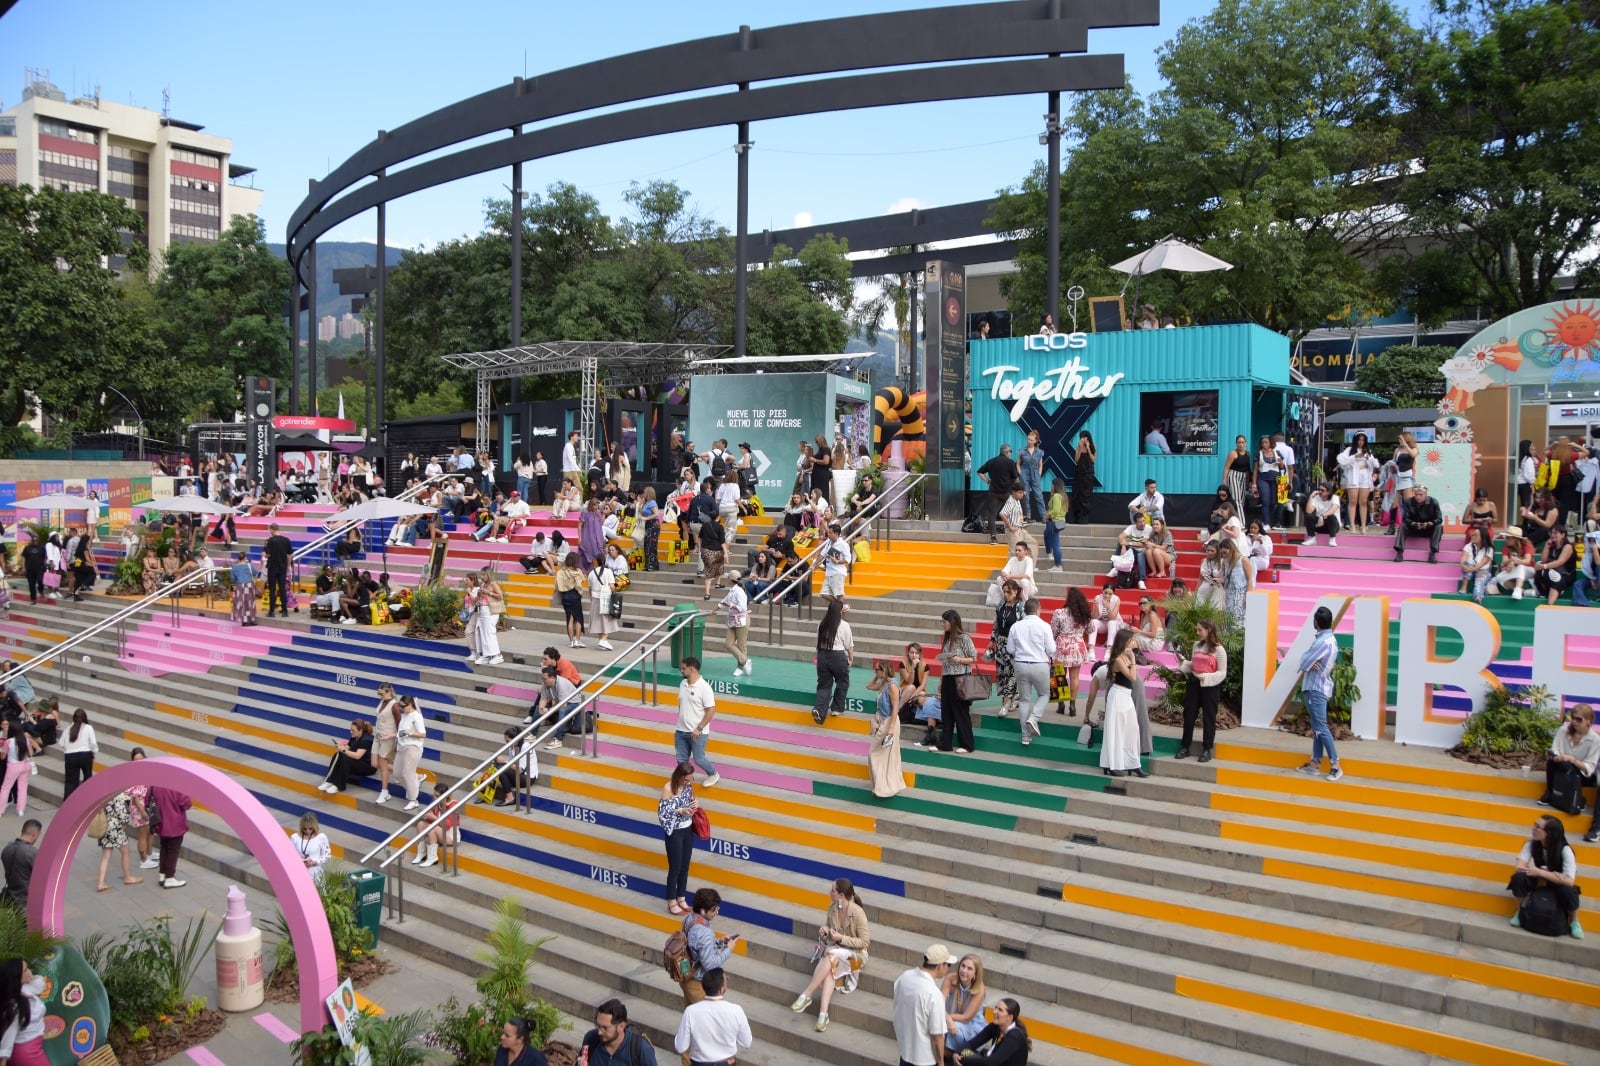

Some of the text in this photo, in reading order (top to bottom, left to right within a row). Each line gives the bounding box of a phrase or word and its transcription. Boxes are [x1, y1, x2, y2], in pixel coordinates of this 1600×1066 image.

[1024, 332, 1087, 351] IQOS
[1290, 353, 1375, 367] OLOMBIA
[983, 356, 1125, 422] Together
[727, 409, 787, 418] MUEVE TUS PIES
[279, 417, 316, 427] gotrendier
[716, 419, 802, 428] AL RITMO DE CONVERSE
[257, 424, 265, 484] LAZA MAYOR
[325, 627, 343, 639] VIBES
[336, 673, 357, 686] VIBES
[707, 679, 739, 695] VIBES
[191, 711, 209, 724] VIBES
[563, 804, 597, 824] VIBES
[709, 838, 750, 860] VIBES
[590, 865, 628, 888] VIBES
